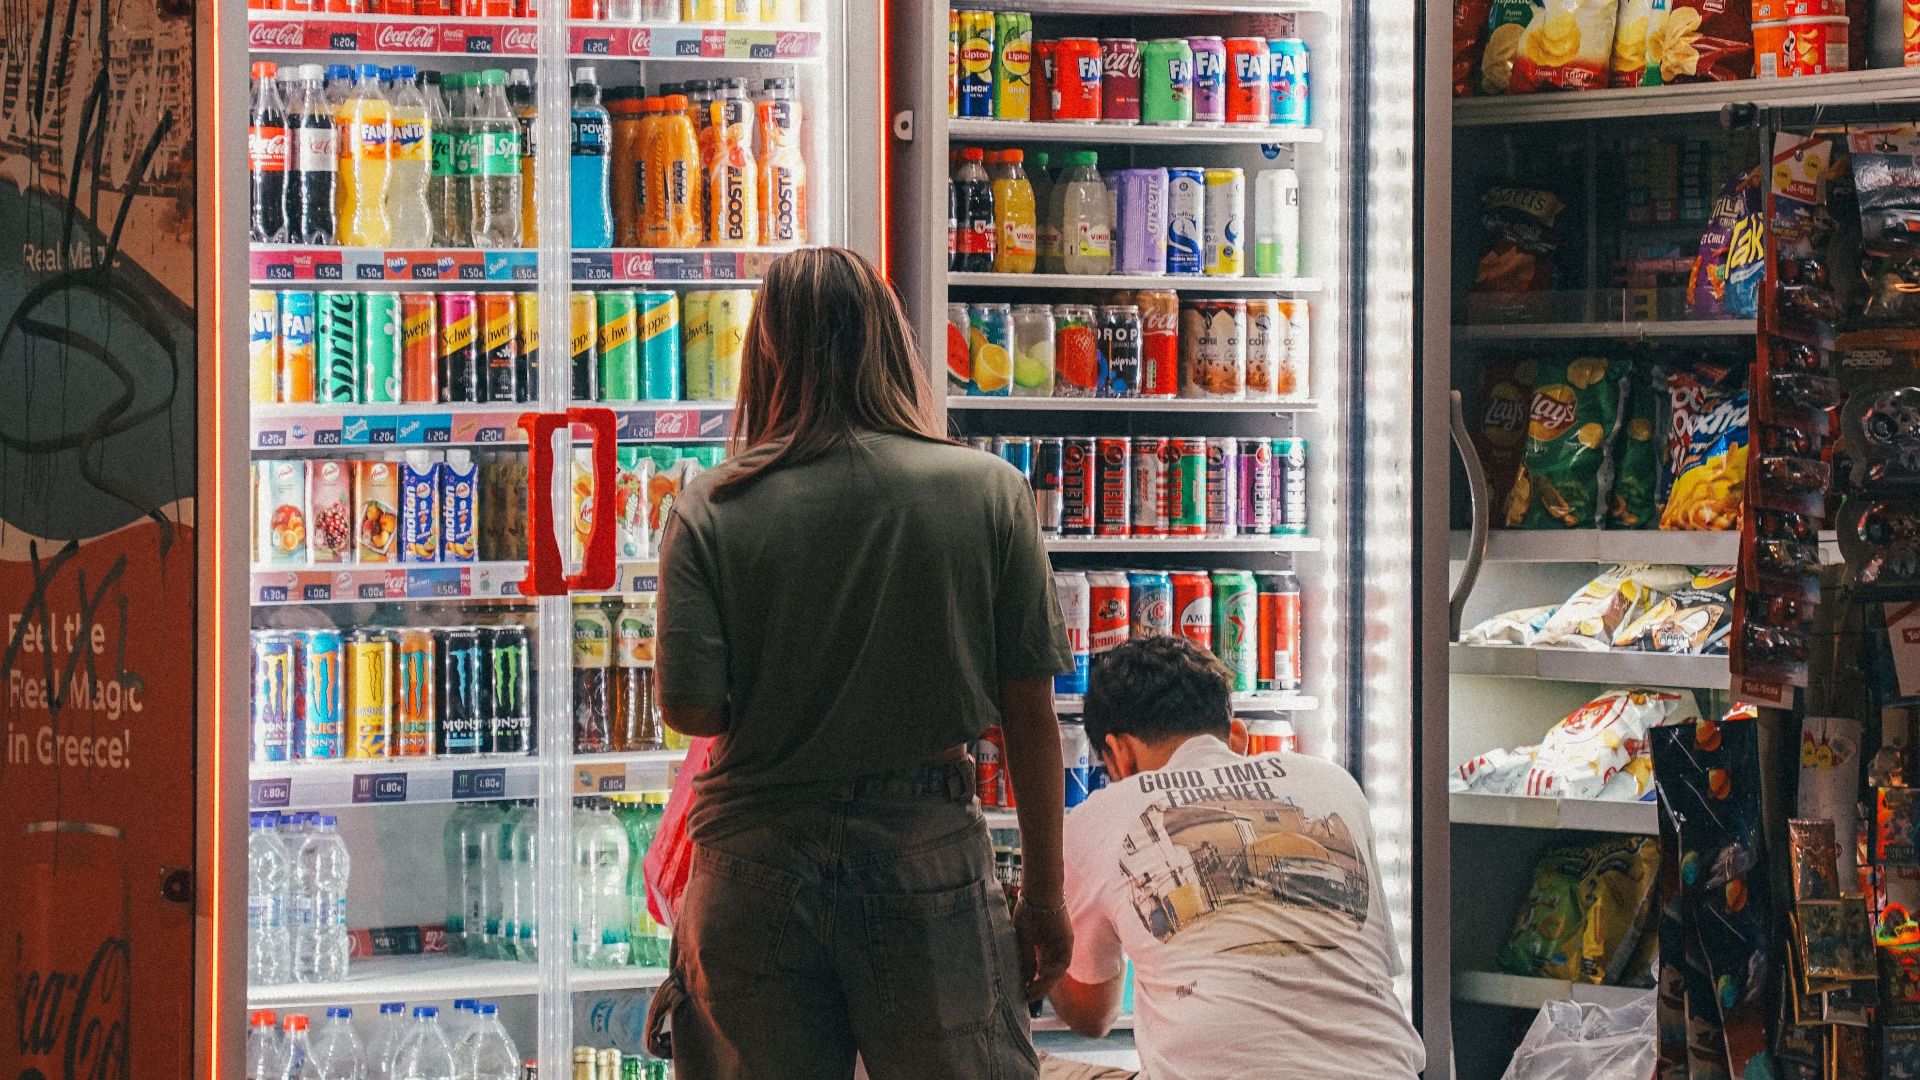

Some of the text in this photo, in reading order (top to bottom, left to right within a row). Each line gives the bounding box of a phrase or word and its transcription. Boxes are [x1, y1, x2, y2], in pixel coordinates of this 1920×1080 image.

[379, 25, 435, 48] Coca-Cola
[964, 50, 989, 60] Lipton
[728, 177, 744, 240] BOOST
[778, 177, 793, 240] BOOST
[23, 243, 62, 272] Real
[386, 257, 408, 268] FANTA
[400, 421, 421, 437] Sprite
[1530, 393, 1575, 429] Lay's
[1103, 468, 1124, 518] HELL
[10, 668, 144, 721] Real Magic
[8, 722, 130, 769] in Greece!
[1138, 757, 1288, 794] GOOD TIMES
[1165, 781, 1278, 808] FOREVER
